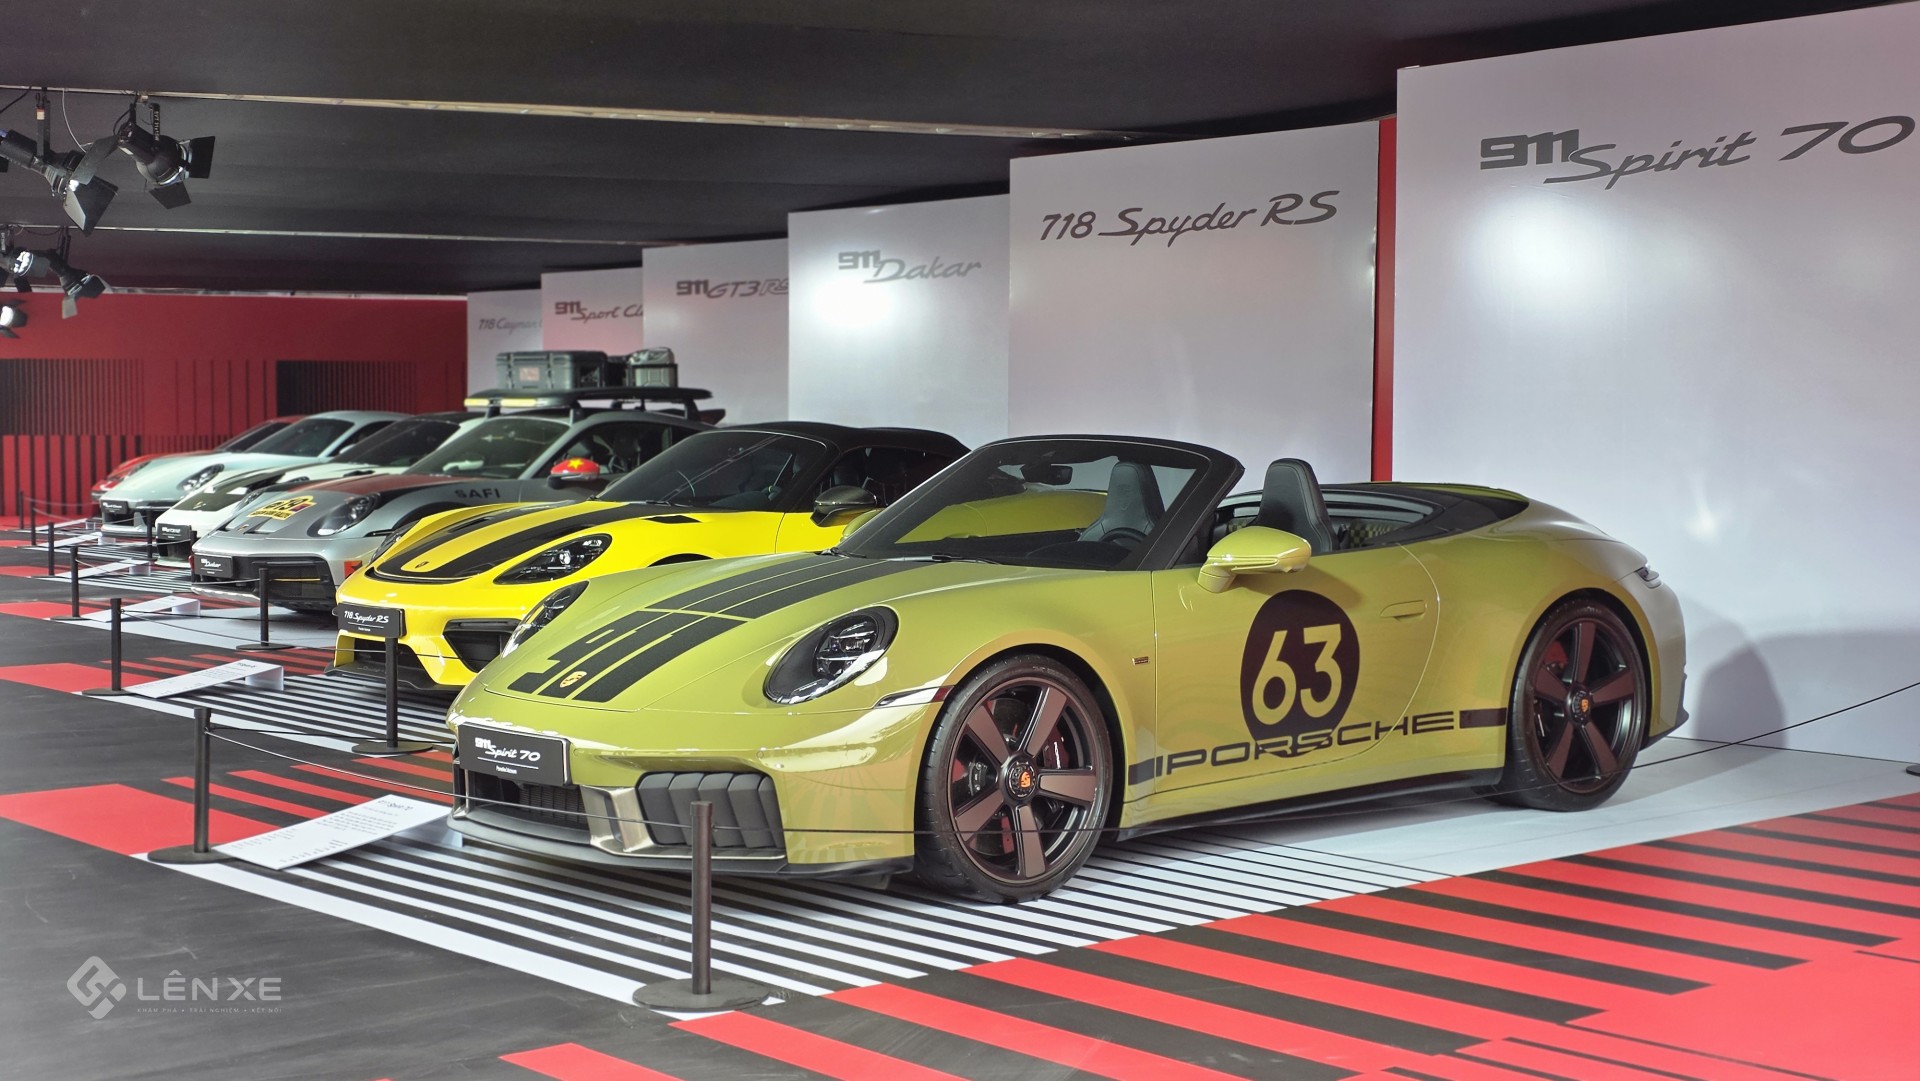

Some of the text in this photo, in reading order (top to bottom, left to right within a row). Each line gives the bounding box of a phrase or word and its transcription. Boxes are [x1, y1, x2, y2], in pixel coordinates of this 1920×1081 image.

[1480, 115, 1915, 190] 911 Spirit 70
[1040, 190, 1340, 247] 718 Spyder RS
[838, 249, 982, 283] 911 Dakar
[676, 279, 709, 296] 911
[478, 318, 496, 330] 718
[555, 300, 581, 315] 911
[571, 305, 622, 324] Sport
[353, 612, 377, 623] Spyder
[376, 614, 389, 624] RS
[1252, 623, 1342, 725] 63
[475, 737, 541, 762] 911 Spirit 70
[1166, 710, 1454, 777] PORSCHE
